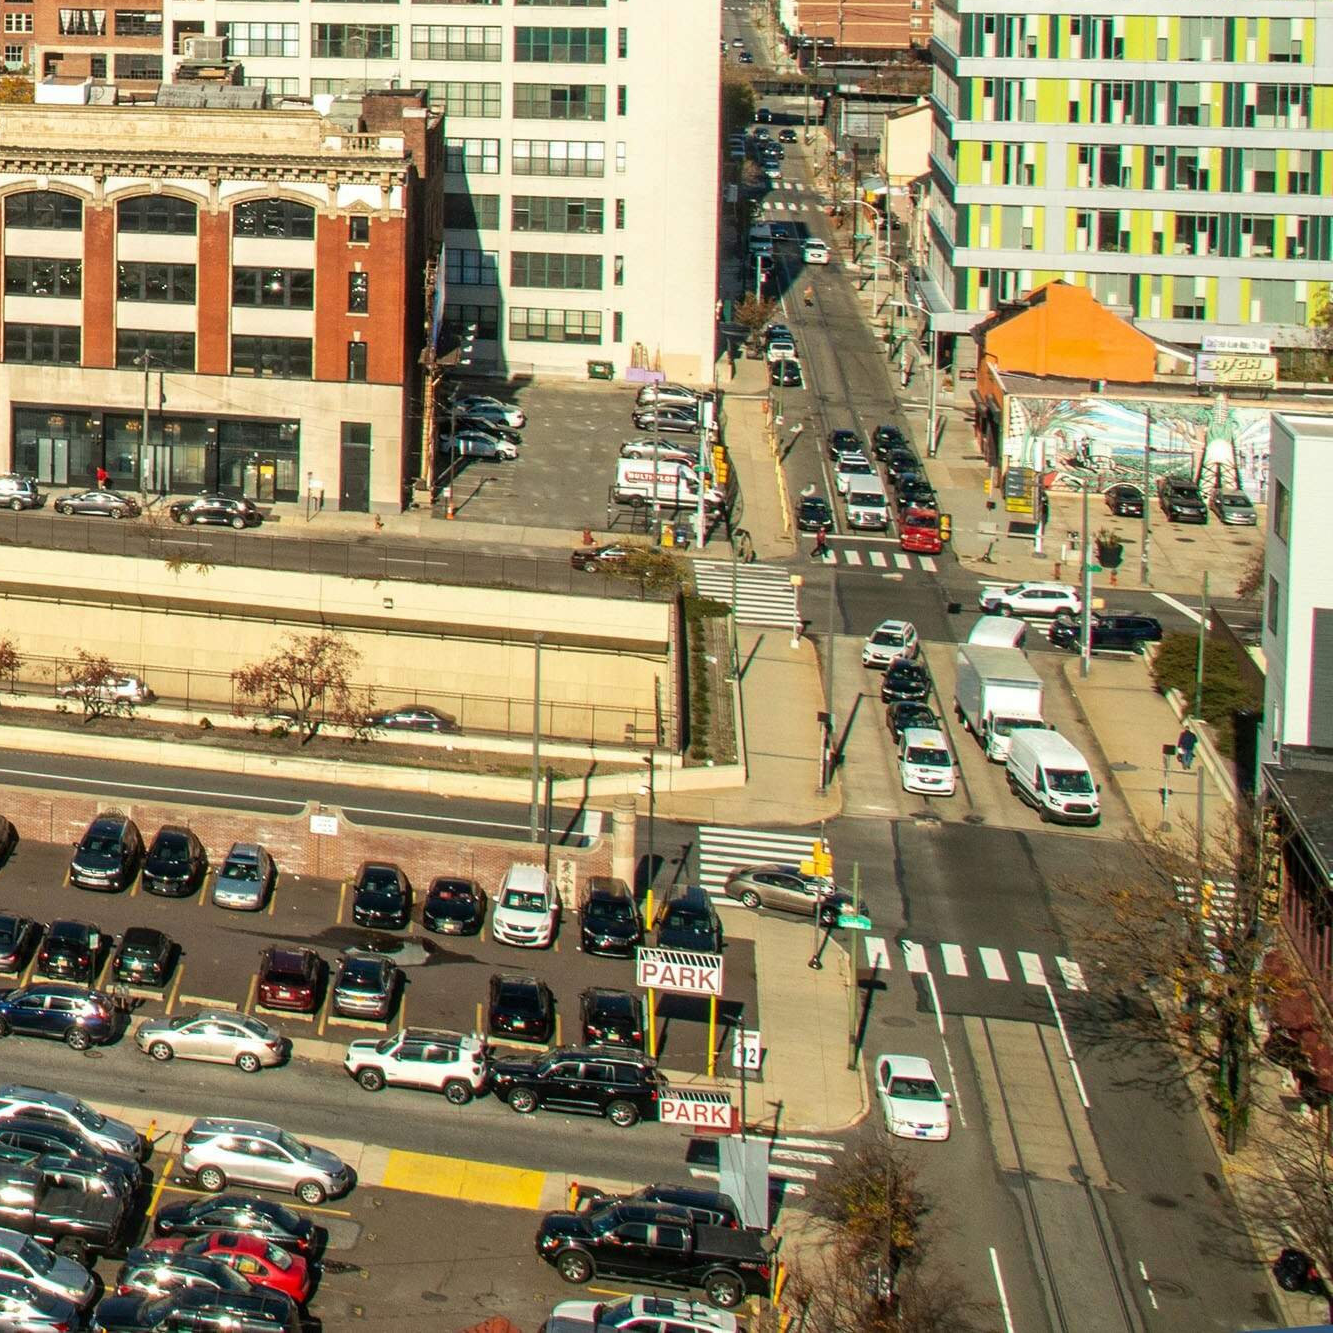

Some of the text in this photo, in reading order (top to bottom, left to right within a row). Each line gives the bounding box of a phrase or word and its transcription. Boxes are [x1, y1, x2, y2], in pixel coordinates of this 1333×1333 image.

[1212, 358, 1274, 382] HIGH END
[642, 963, 716, 991] PARK
[661, 1101, 727, 1124] PARK
